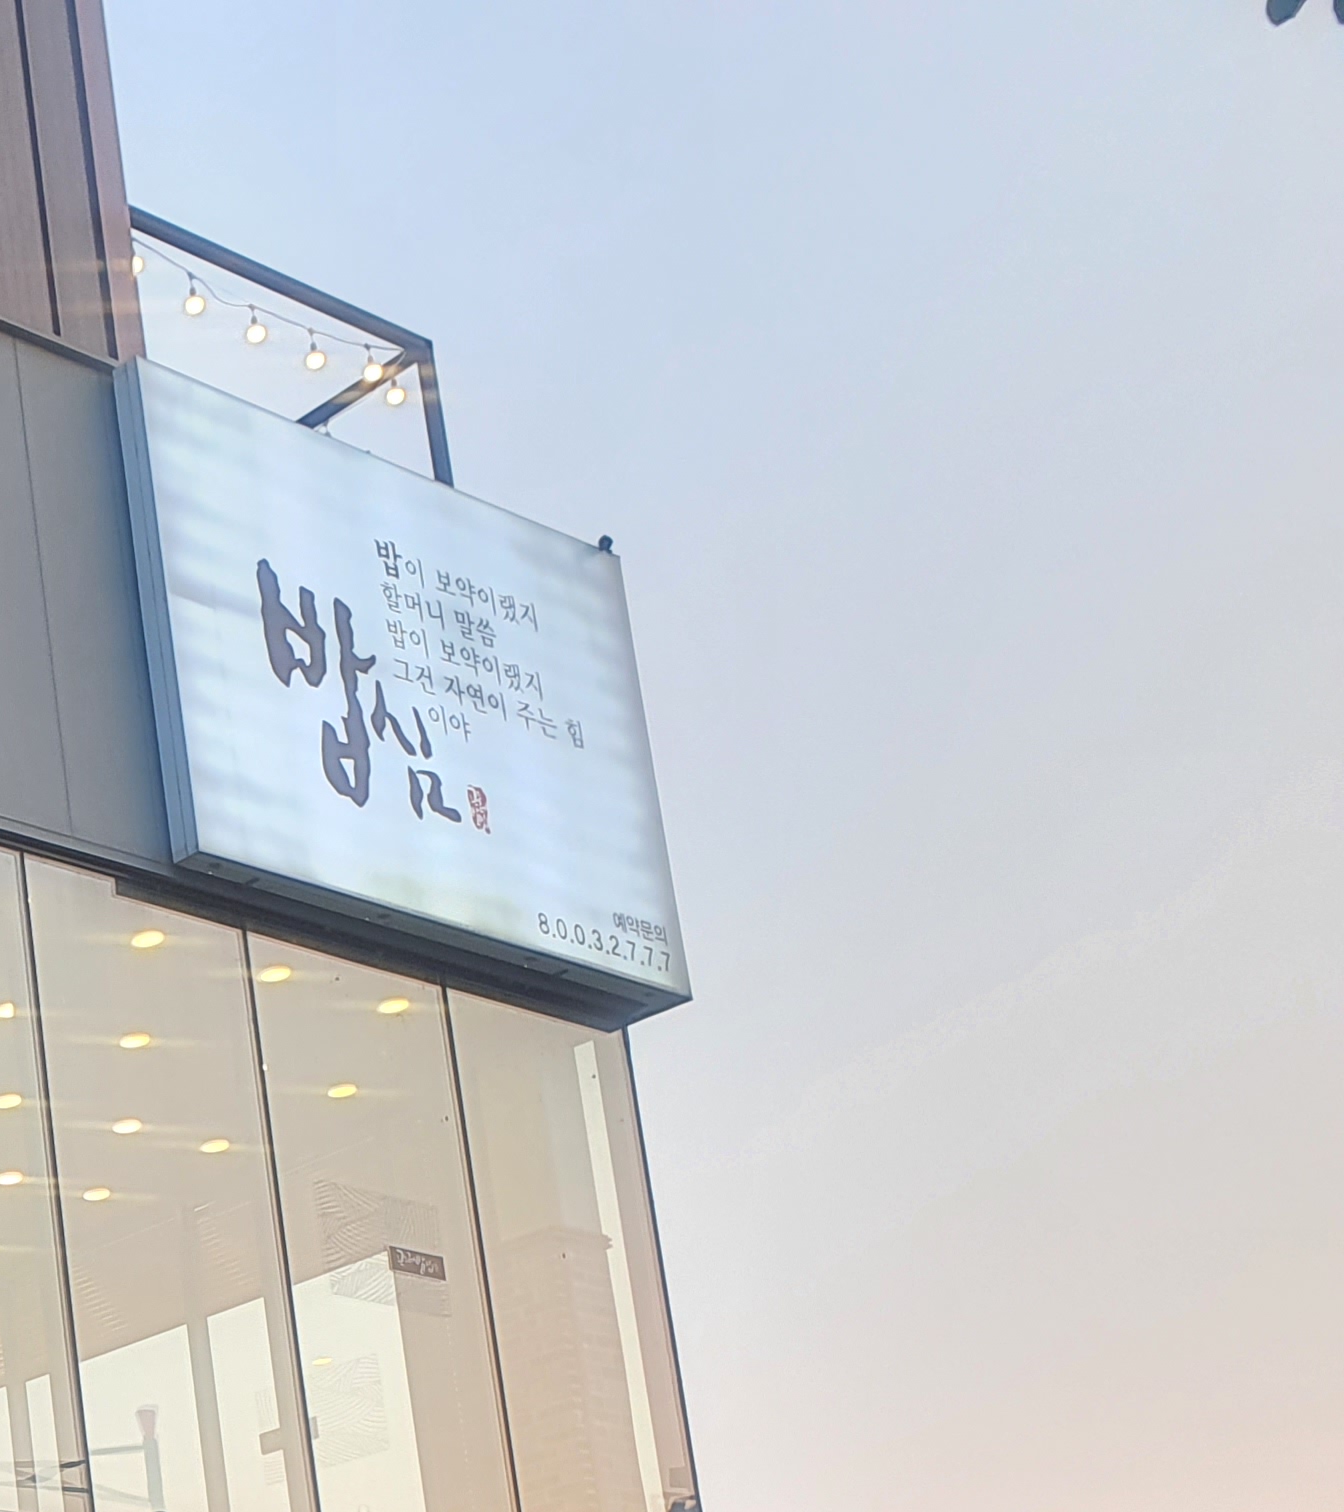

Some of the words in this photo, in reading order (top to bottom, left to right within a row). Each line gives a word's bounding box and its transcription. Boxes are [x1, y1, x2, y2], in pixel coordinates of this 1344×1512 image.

[374, 539, 424, 589] 밥이
[435, 570, 538, 632] 보약이랬지
[381, 582, 445, 631] 할머니
[454, 610, 496, 648] 말씀
[257, 558, 462, 823] 밥심
[386, 619, 429, 659] 밥이
[440, 639, 543, 701] 보약이랬지
[393, 658, 436, 695] 그건
[443, 675, 507, 721] 자연이
[517, 700, 557, 739] 주는
[565, 719, 585, 749] 힘
[428, 705, 471, 743] 이야
[613, 912, 668, 946] 예약문의
